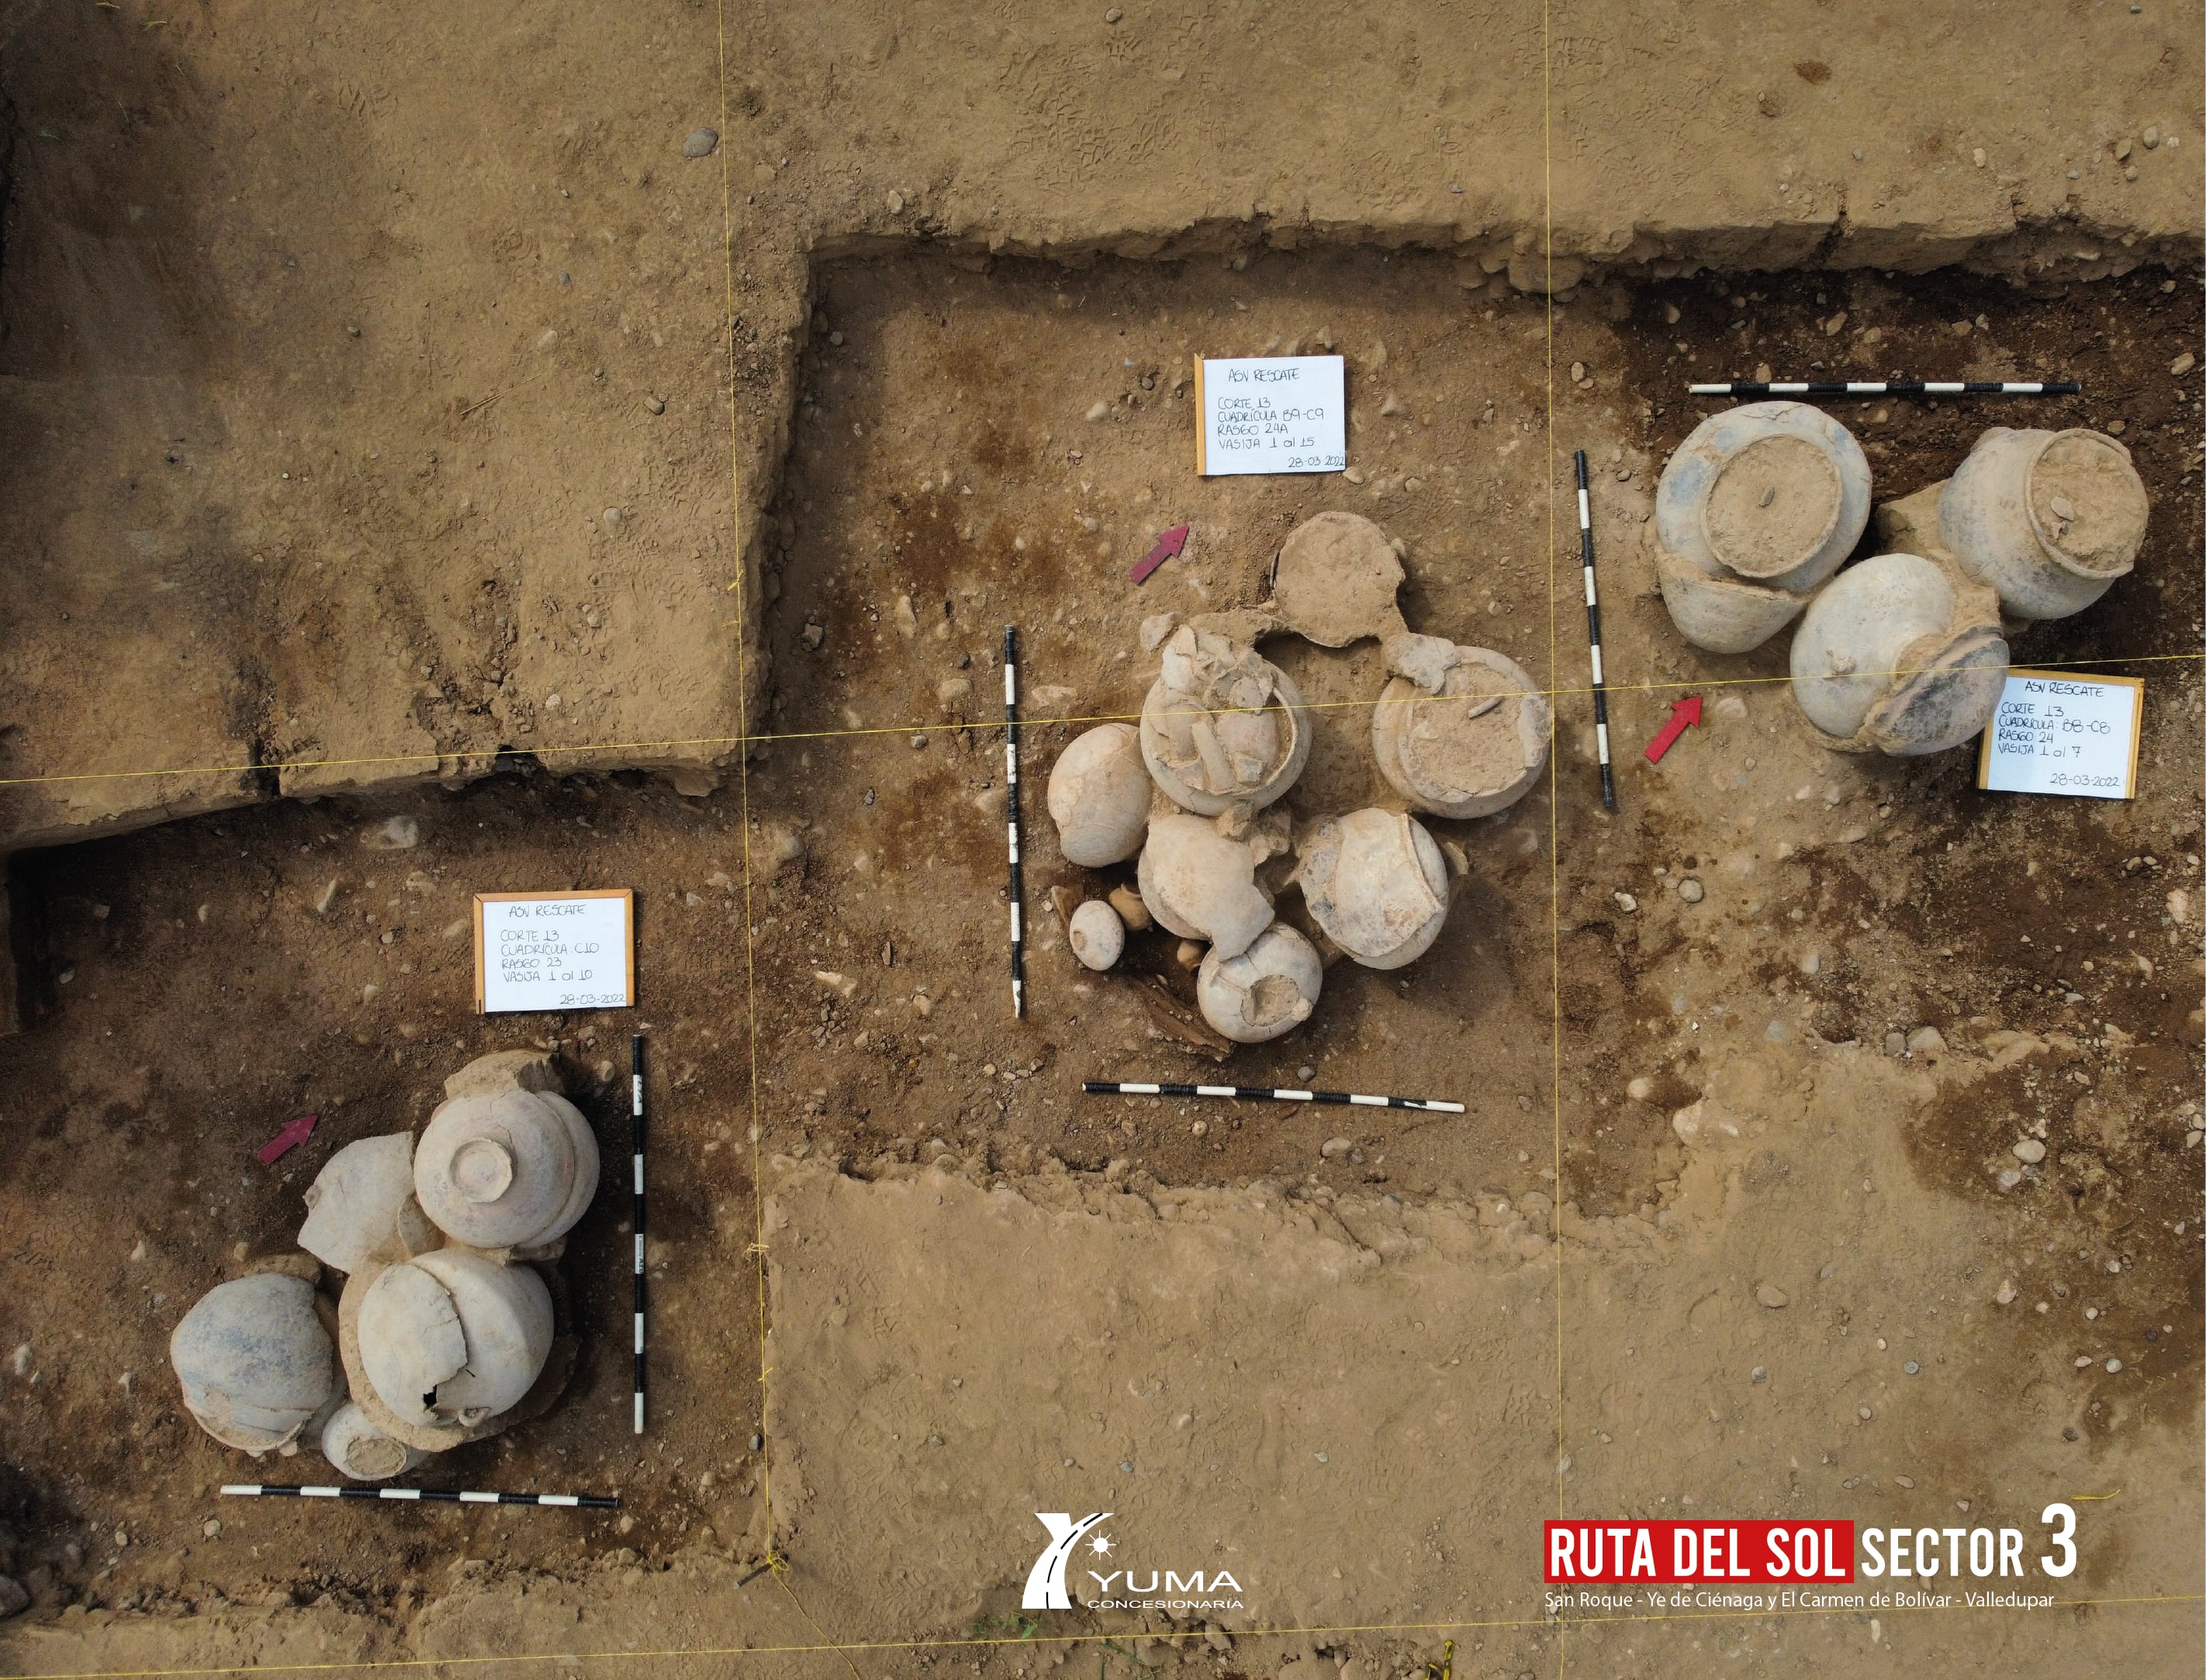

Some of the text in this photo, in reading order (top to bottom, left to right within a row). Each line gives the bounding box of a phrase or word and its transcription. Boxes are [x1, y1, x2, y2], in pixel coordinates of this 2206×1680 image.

[1229, 368, 1300, 382] ASV RESCATE
[1218, 397, 1271, 410] CORTE 13
[1283, 408, 1324, 421] B9-C9
[1218, 423, 1288, 437] RASGO 24A
[1219, 437, 1315, 449] VASIJA 1 al 15
[2025, 681, 2104, 697] ASV RESCATE
[2001, 701, 2063, 717] CORTE 13
[2062, 719, 2111, 734] B8-C8
[1999, 728, 2053, 743] RASGO 24
[1998, 743, 2034, 755] VASIJA
[2039, 745, 2049, 755] 1
[2073, 746, 2081, 757] 7
[2050, 773, 2121, 786] 28-03-2022
[509, 904, 586, 918] ASV RESCATE
[500, 929, 558, 942] CORTE 13
[575, 942, 599, 953] C10
[502, 958, 562, 970] RASGO 23
[503, 970, 592, 982] VASIJA 1 al 10
[560, 994, 626, 1004] 28-03-2022
